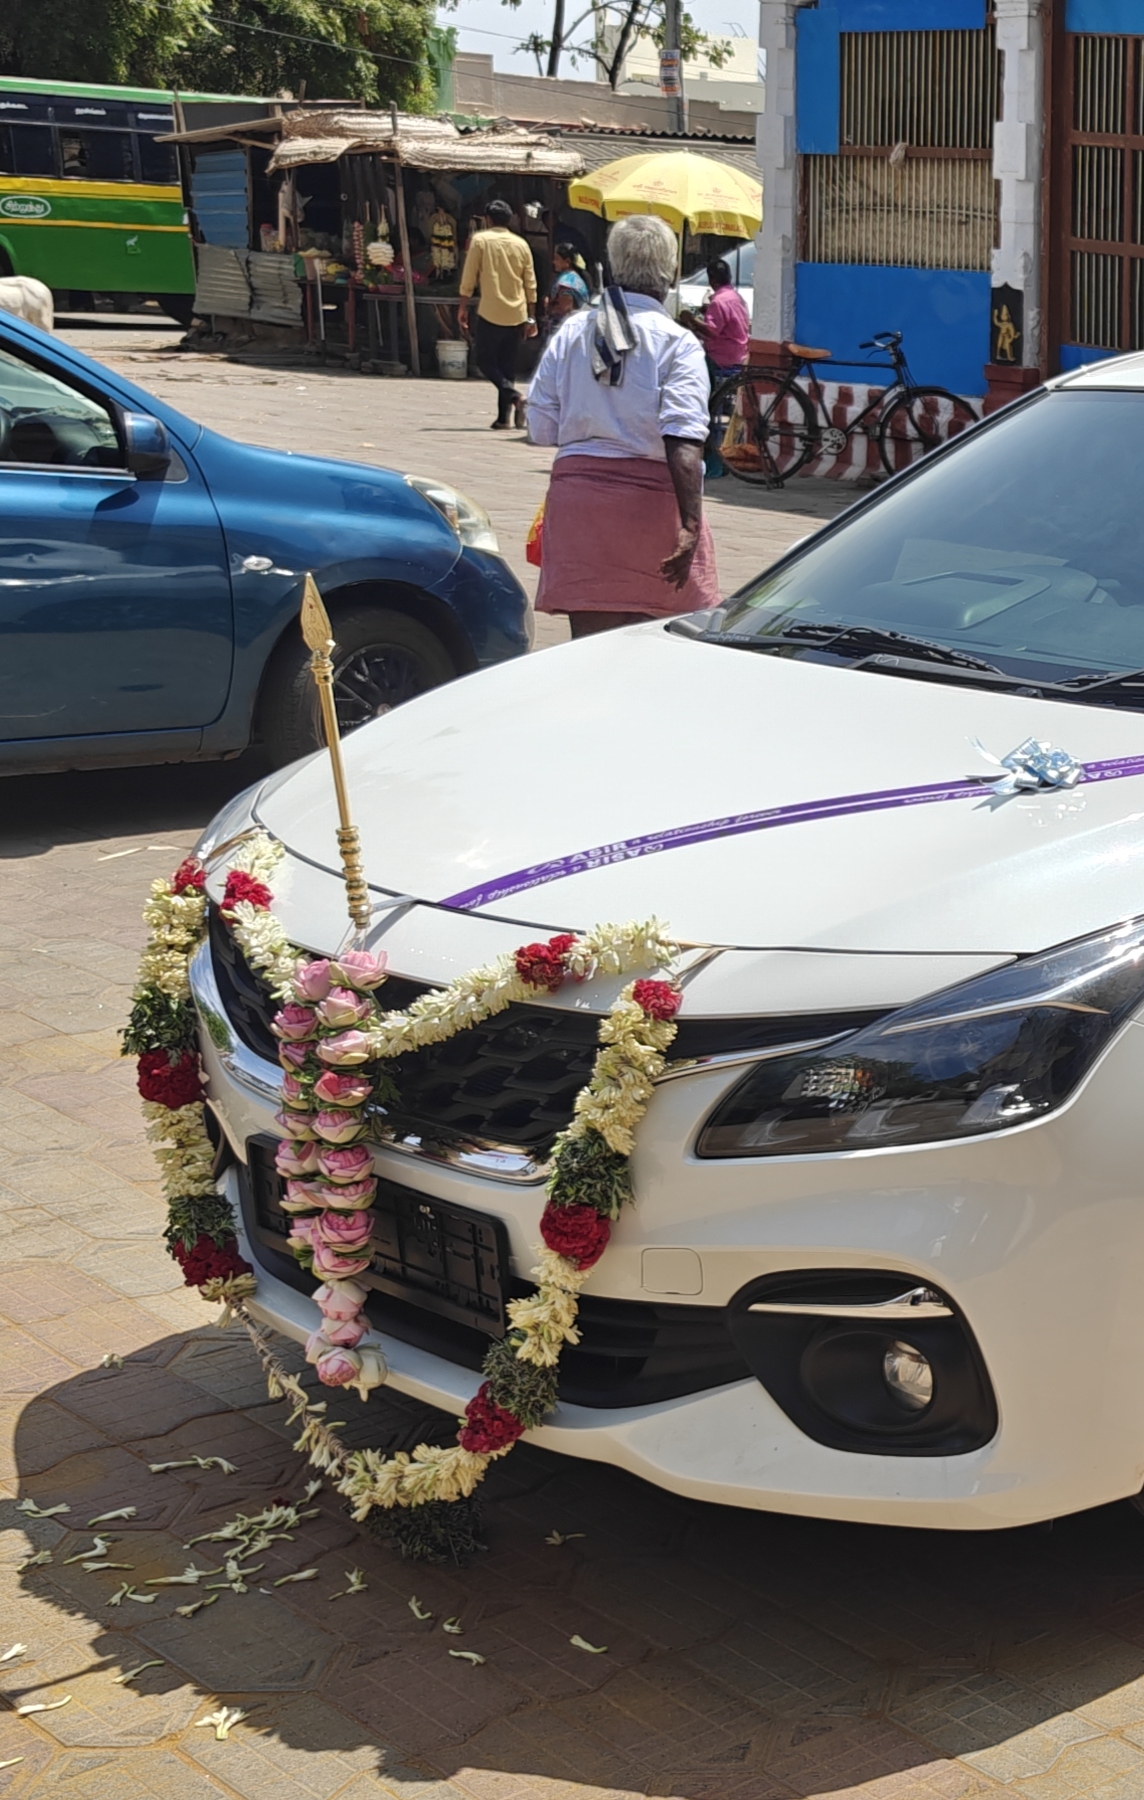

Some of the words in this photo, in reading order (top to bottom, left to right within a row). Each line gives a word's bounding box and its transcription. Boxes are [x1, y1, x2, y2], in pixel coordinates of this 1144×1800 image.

[569, 842, 629, 864] ASIR
[586, 848, 643, 869] ASIR
[487, 869, 567, 900] relationship
